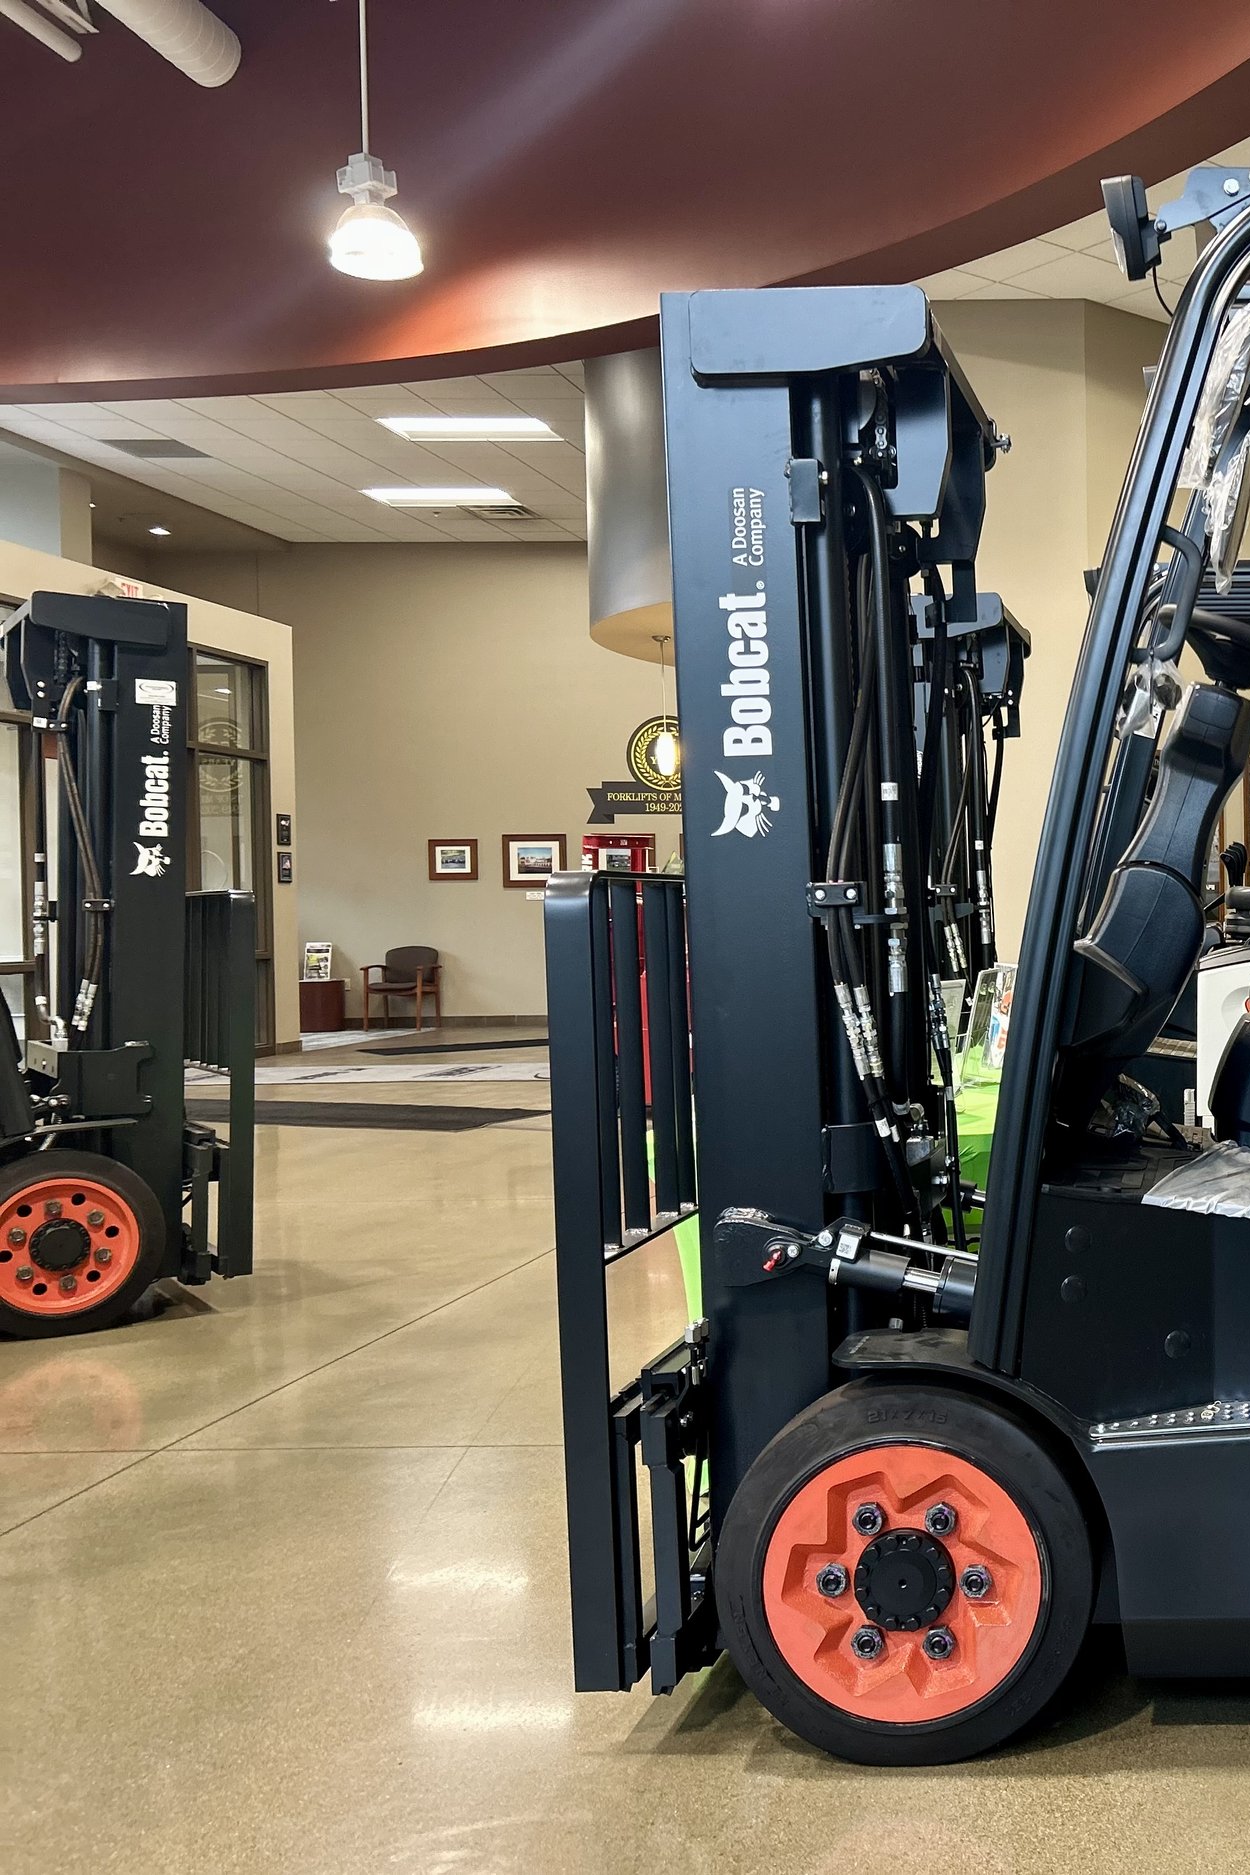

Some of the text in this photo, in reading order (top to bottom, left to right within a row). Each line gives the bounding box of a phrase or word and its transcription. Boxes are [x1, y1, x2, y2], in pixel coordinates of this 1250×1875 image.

[731, 487, 748, 567] A Doosan
[748, 487, 767, 567] Company
[150, 704, 161, 735] Doosan
[160, 705, 172, 745] Company
[606, 792, 658, 802] FORKLIFTS
[659, 792, 673, 802] OF
